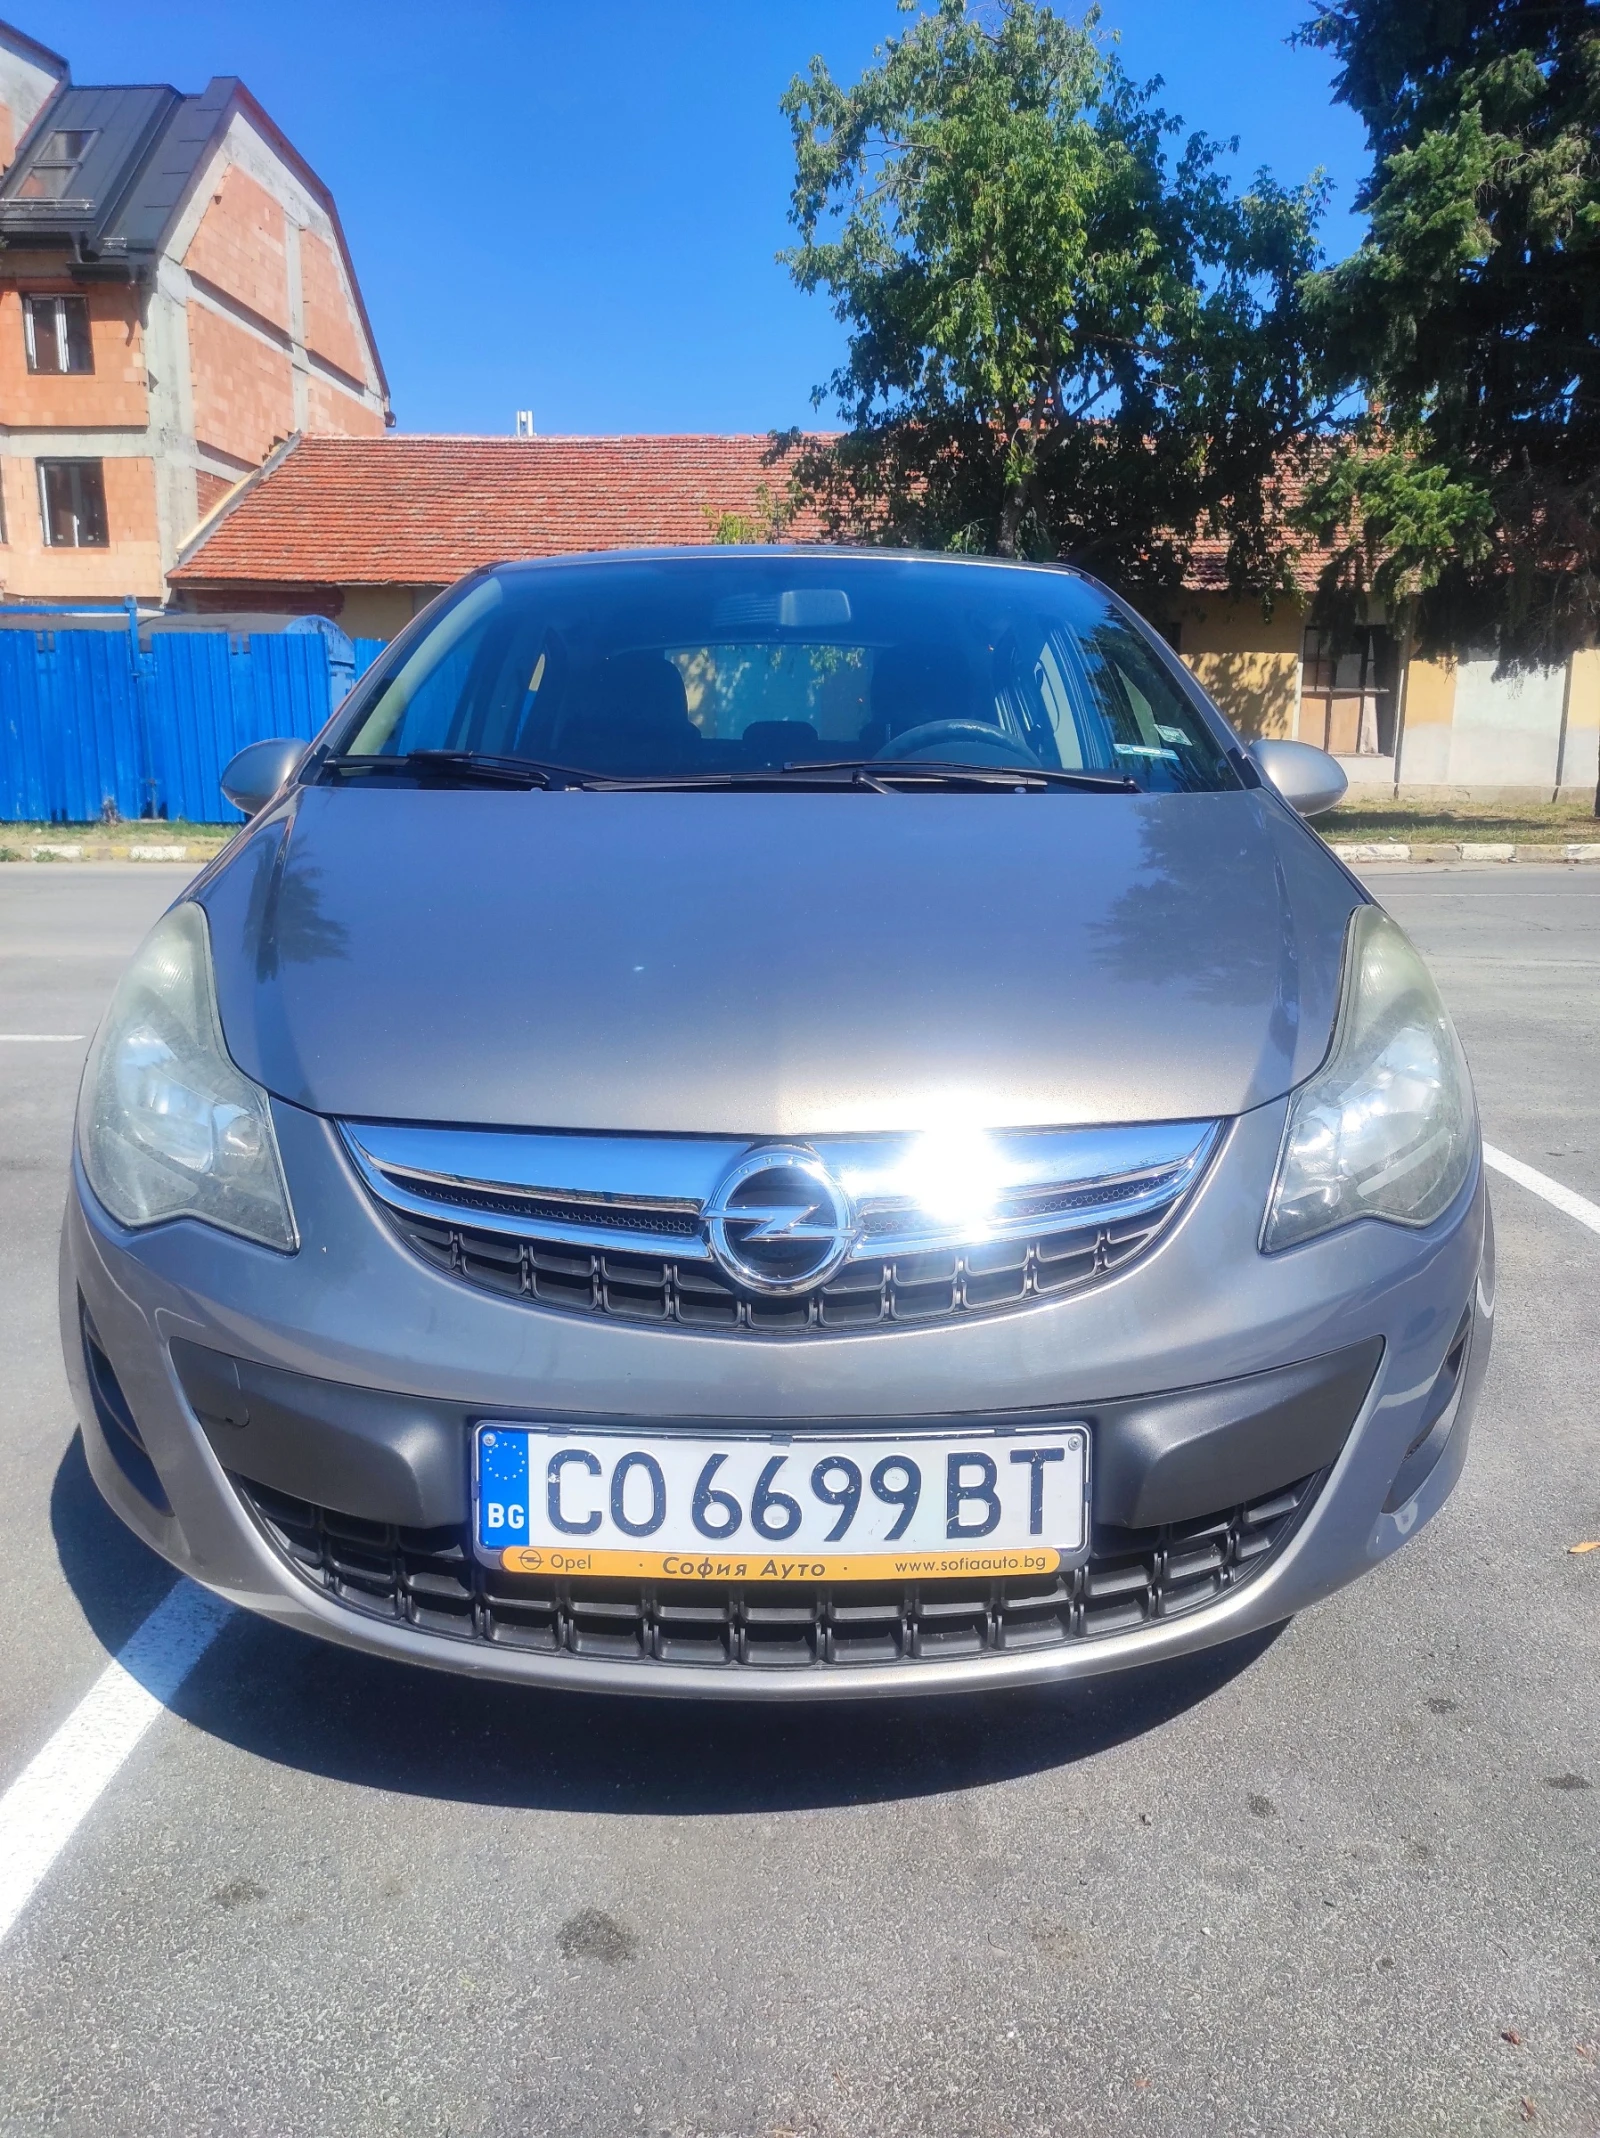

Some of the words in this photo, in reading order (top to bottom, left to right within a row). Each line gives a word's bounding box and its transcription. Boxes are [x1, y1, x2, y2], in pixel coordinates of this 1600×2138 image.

[487, 1502, 525, 1529] BG
[550, 1553, 592, 1570] Opel
[662, 1557, 748, 1579] София
[760, 1559, 826, 1579] Ауто
[894, 1554, 1046, 1574] www.sofiaauto.bg
